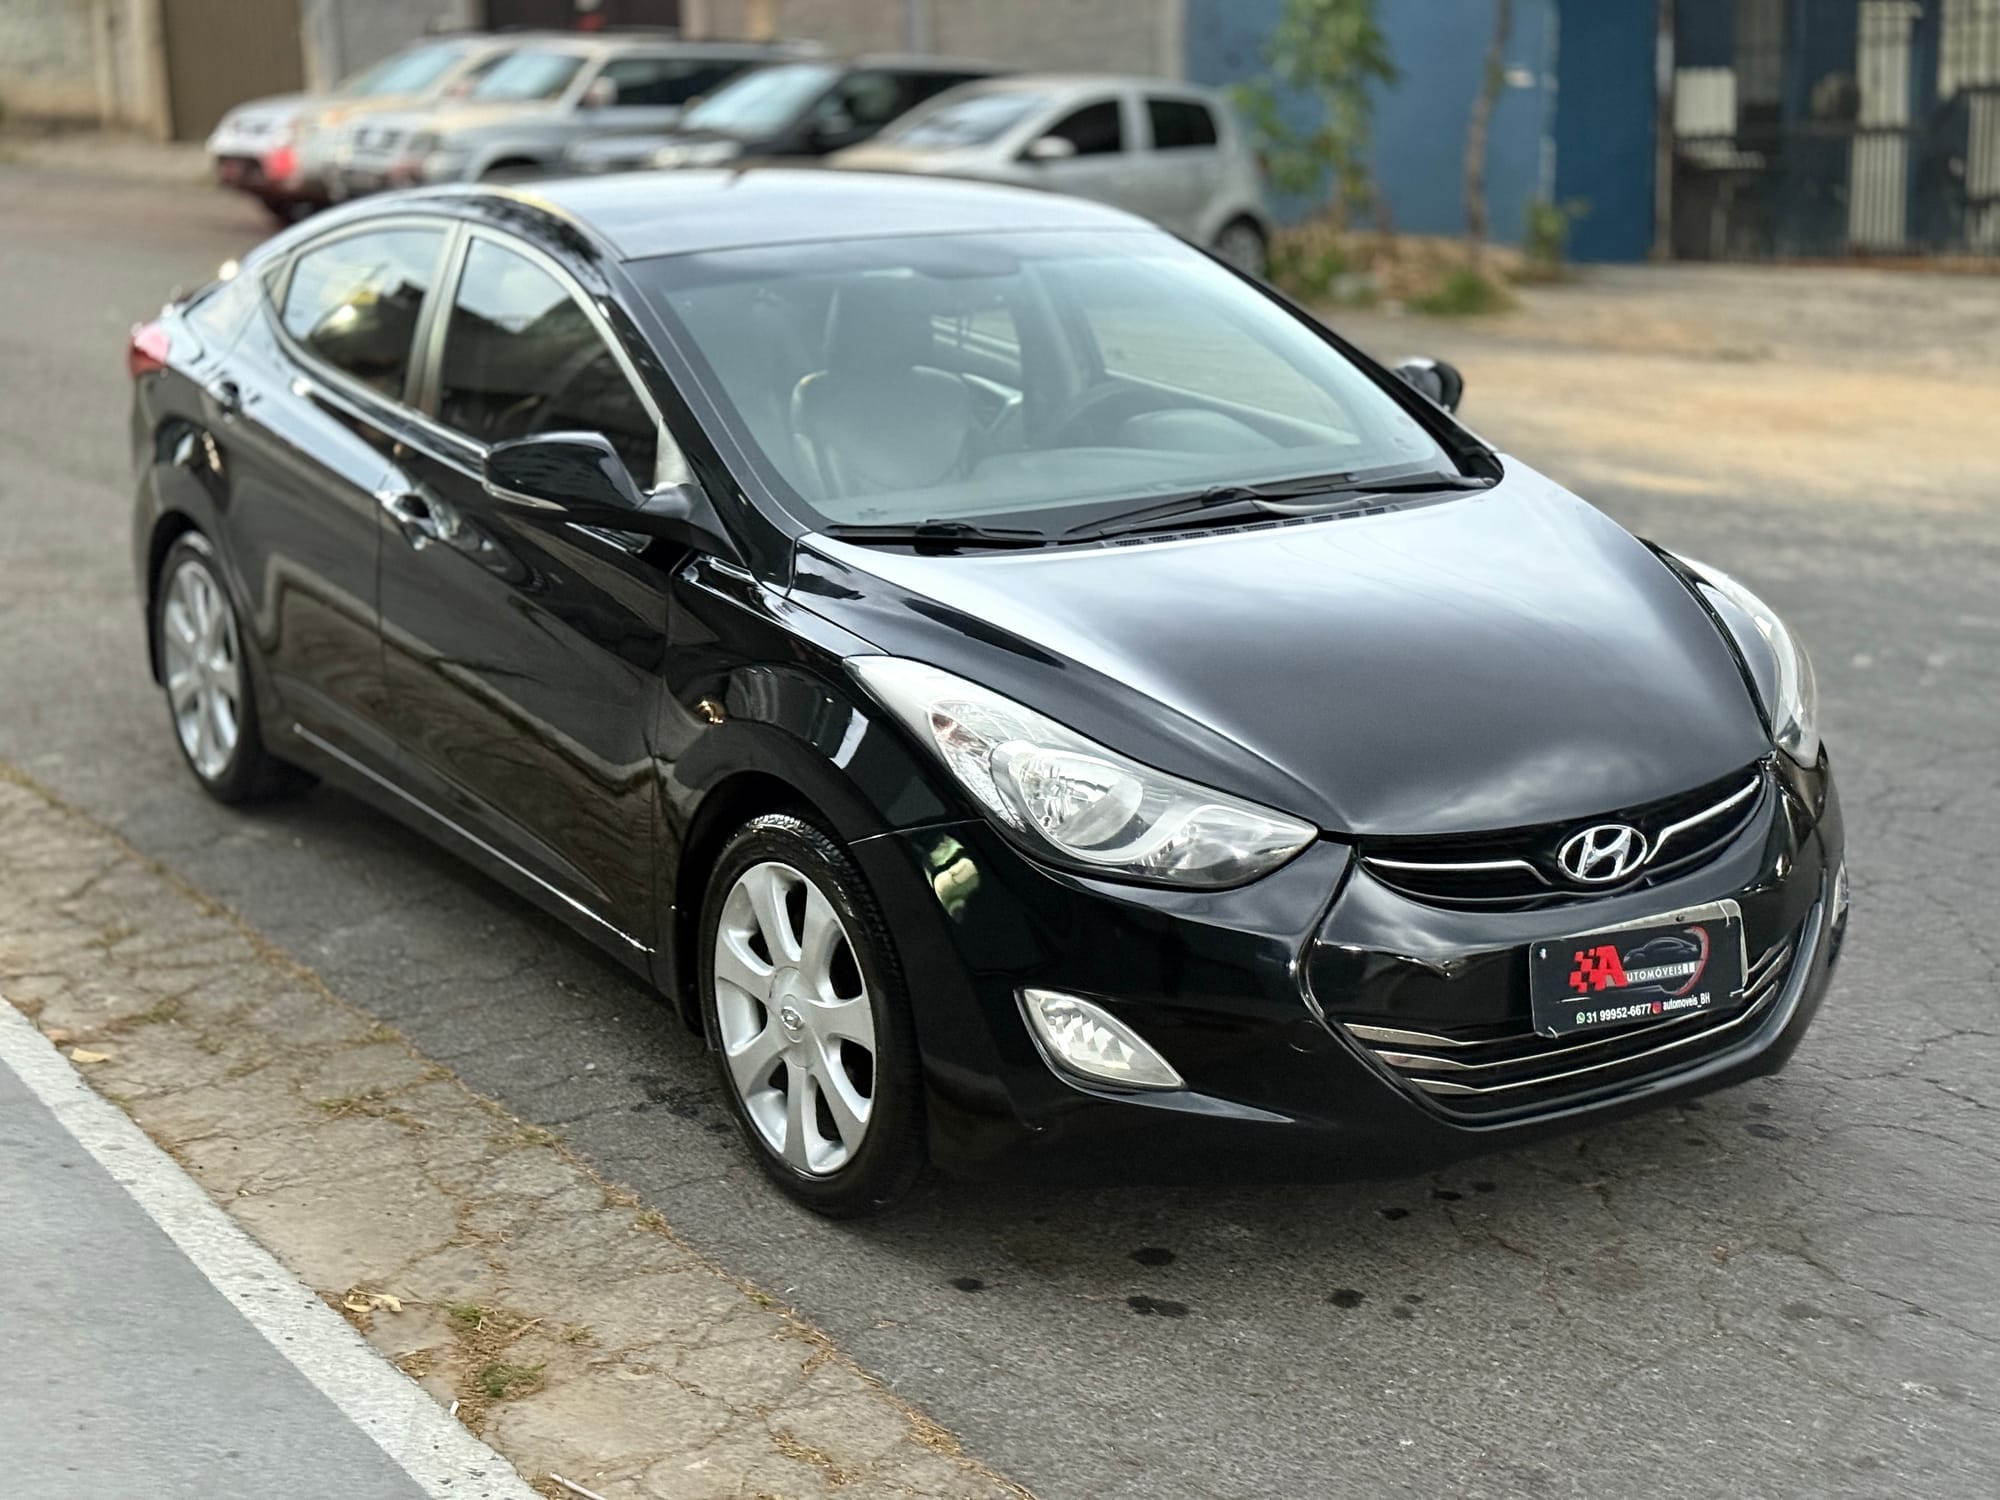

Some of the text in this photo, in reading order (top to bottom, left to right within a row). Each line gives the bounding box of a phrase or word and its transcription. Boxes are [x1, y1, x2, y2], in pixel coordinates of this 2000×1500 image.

[1586, 992, 1711, 1024] 31 99952-6677 automoveis_BH
